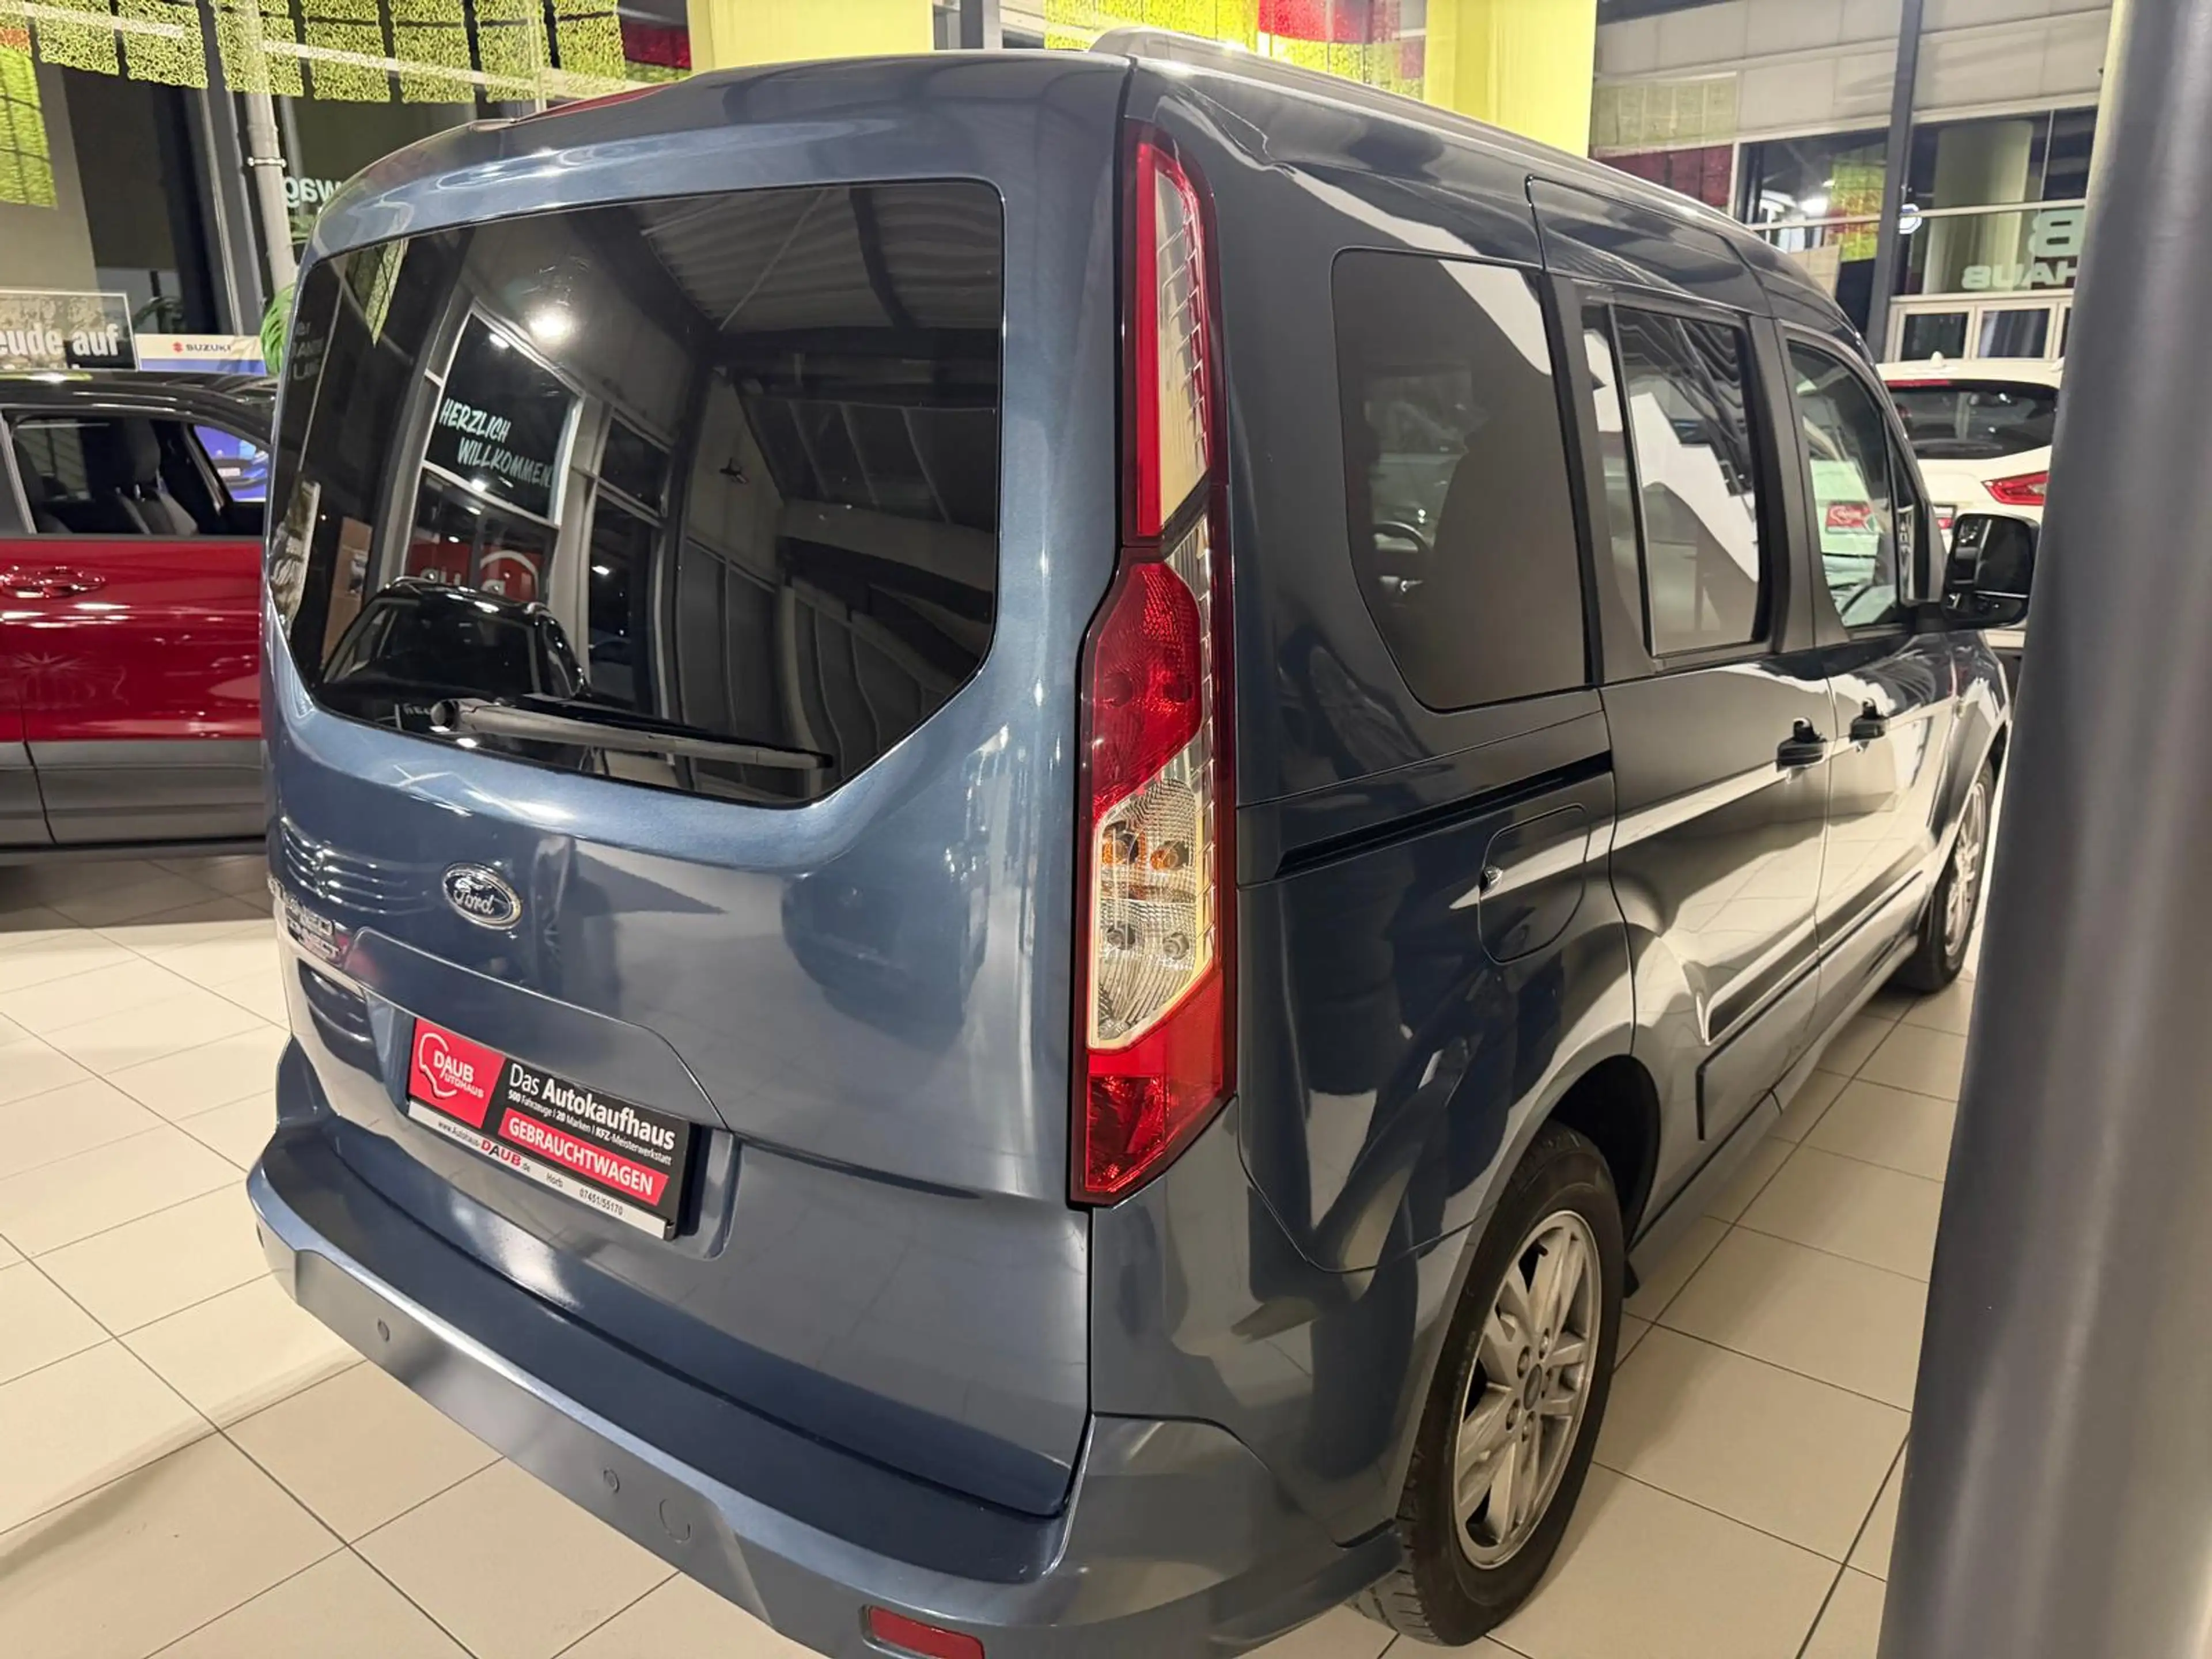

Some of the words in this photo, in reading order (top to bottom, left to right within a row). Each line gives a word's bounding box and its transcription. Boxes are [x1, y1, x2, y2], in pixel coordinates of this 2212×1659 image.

[71, 323, 119, 356] auf
[185, 343, 232, 353] SUZUKI
[439, 397, 512, 443] HERZLICH
[457, 437, 555, 488] WILLKOMMEN
[453, 877, 494, 915] Ford
[433, 1050, 474, 1084] DAUB
[510, 1063, 540, 1096] Das
[541, 1078, 675, 1150] Autokaufhaus
[509, 1117, 654, 1196] GEBRAUCHTWAGEN
